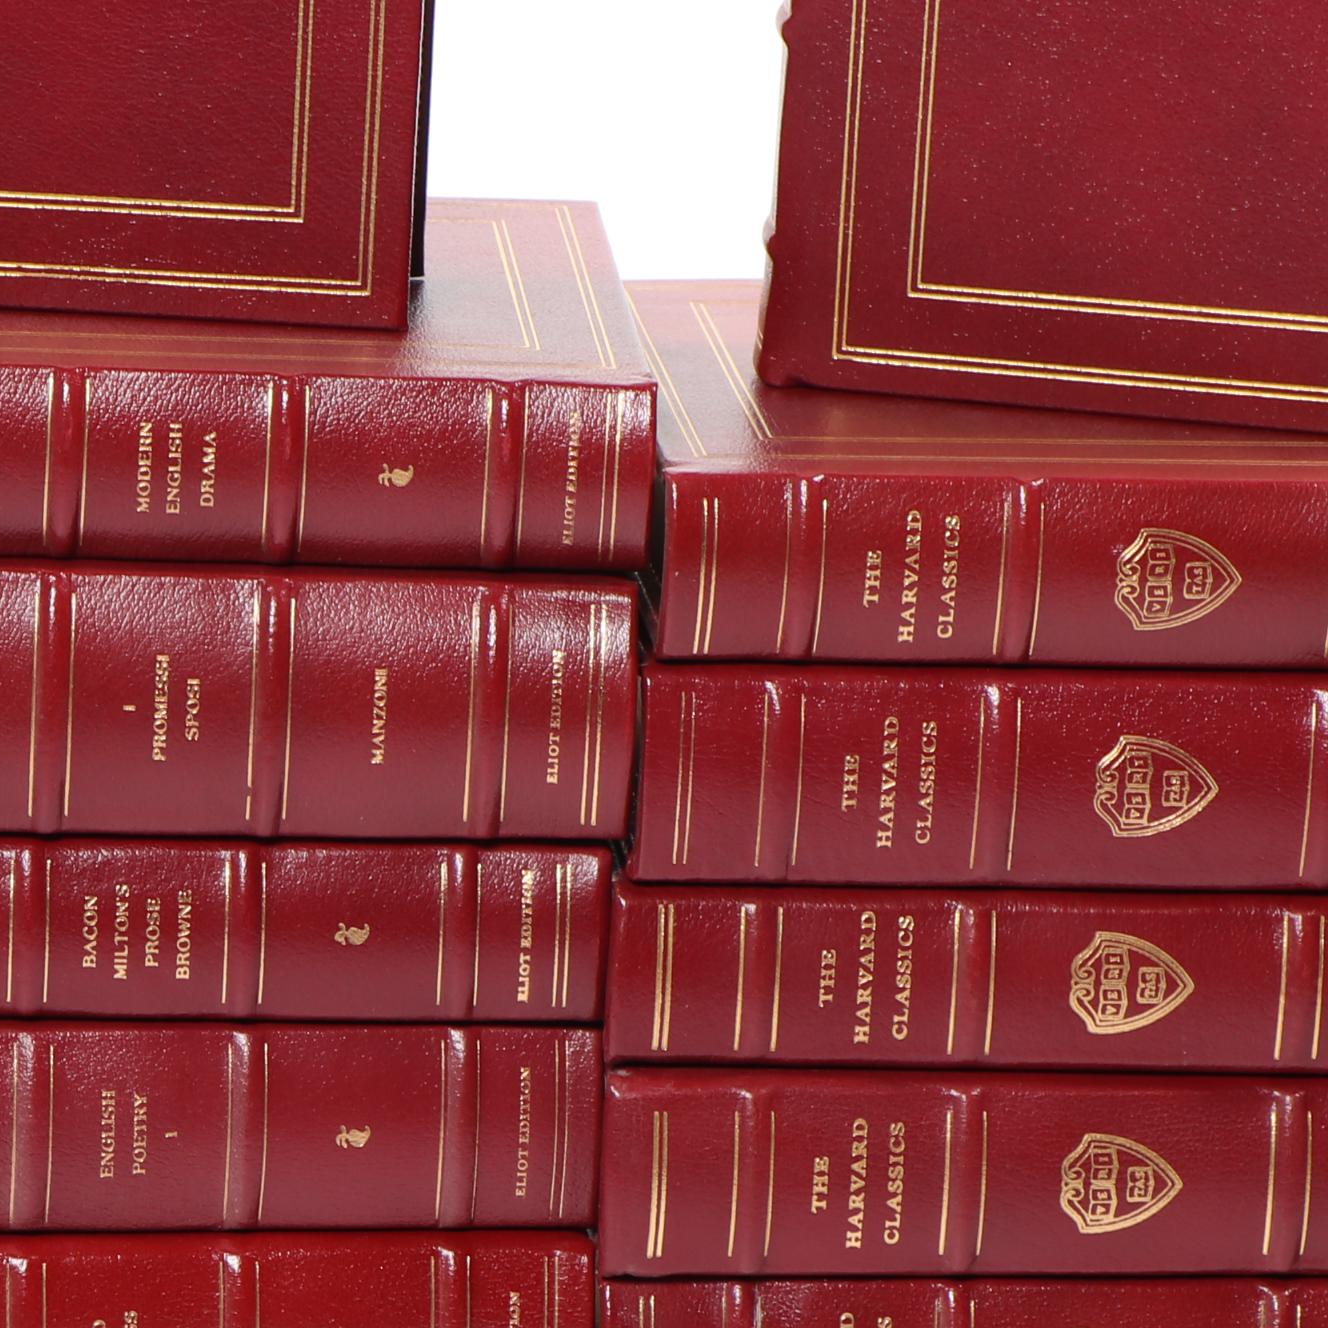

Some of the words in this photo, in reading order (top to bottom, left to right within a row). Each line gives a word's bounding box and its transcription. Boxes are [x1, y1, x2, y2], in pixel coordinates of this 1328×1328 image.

[136, 421, 153, 513] MODERN
[166, 422, 183, 515] ENGLISH
[200, 431, 217, 507] DRAMA
[863, 550, 881, 607] THE
[898, 510, 923, 643] HARVARD
[937, 514, 961, 639] CLASSICS
[152, 654, 169, 761] PROMESSI
[184, 678, 200, 741] SPOSI
[371, 667, 387, 764] MANZONI
[841, 754, 860, 812] THE
[876, 716, 901, 848] HARVARD
[915, 720, 938, 845] CLASSICS
[82, 895, 98, 968] BACON
[113, 884, 130, 980] MILTON'S
[145, 897, 160, 967] PROSE
[176, 890, 192, 980] BROWNE
[854, 910, 877, 1044] HARVARD
[818, 949, 837, 1007] THE
[893, 915, 915, 1040] CLASSICS
[100, 1089, 116, 1179] ENGLISH
[132, 1092, 148, 1174] POETRY
[518, 1067, 530, 1144] EDITION
[516, 1147, 528, 1196] ELIOT
[811, 1155, 829, 1214] THE
[847, 1117, 868, 1249] HARVARD
[884, 1121, 905, 1245] CLASSICS
